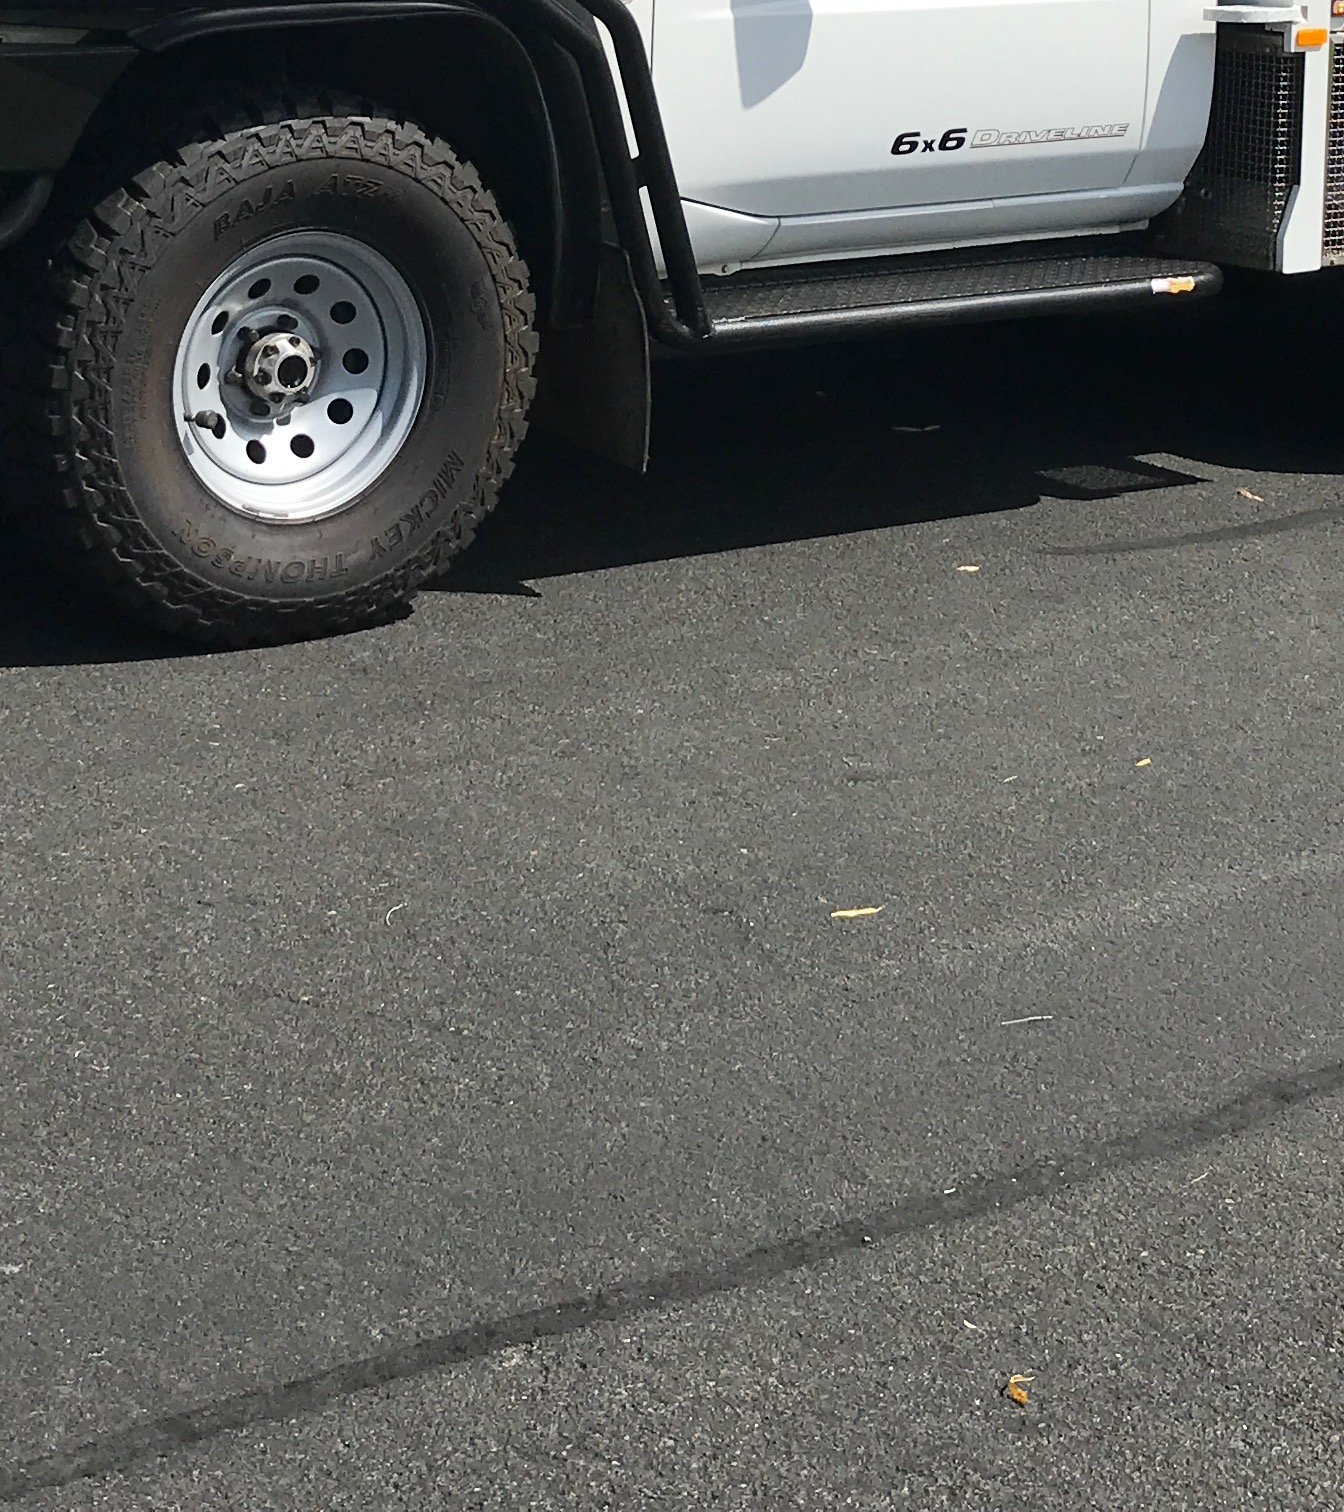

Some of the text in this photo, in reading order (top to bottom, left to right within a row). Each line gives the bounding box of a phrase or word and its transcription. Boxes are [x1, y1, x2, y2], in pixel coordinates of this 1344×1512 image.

[890, 127, 968, 155] 6x6
[213, 179, 296, 241] BAJA
[368, 450, 466, 561] MICKEY
